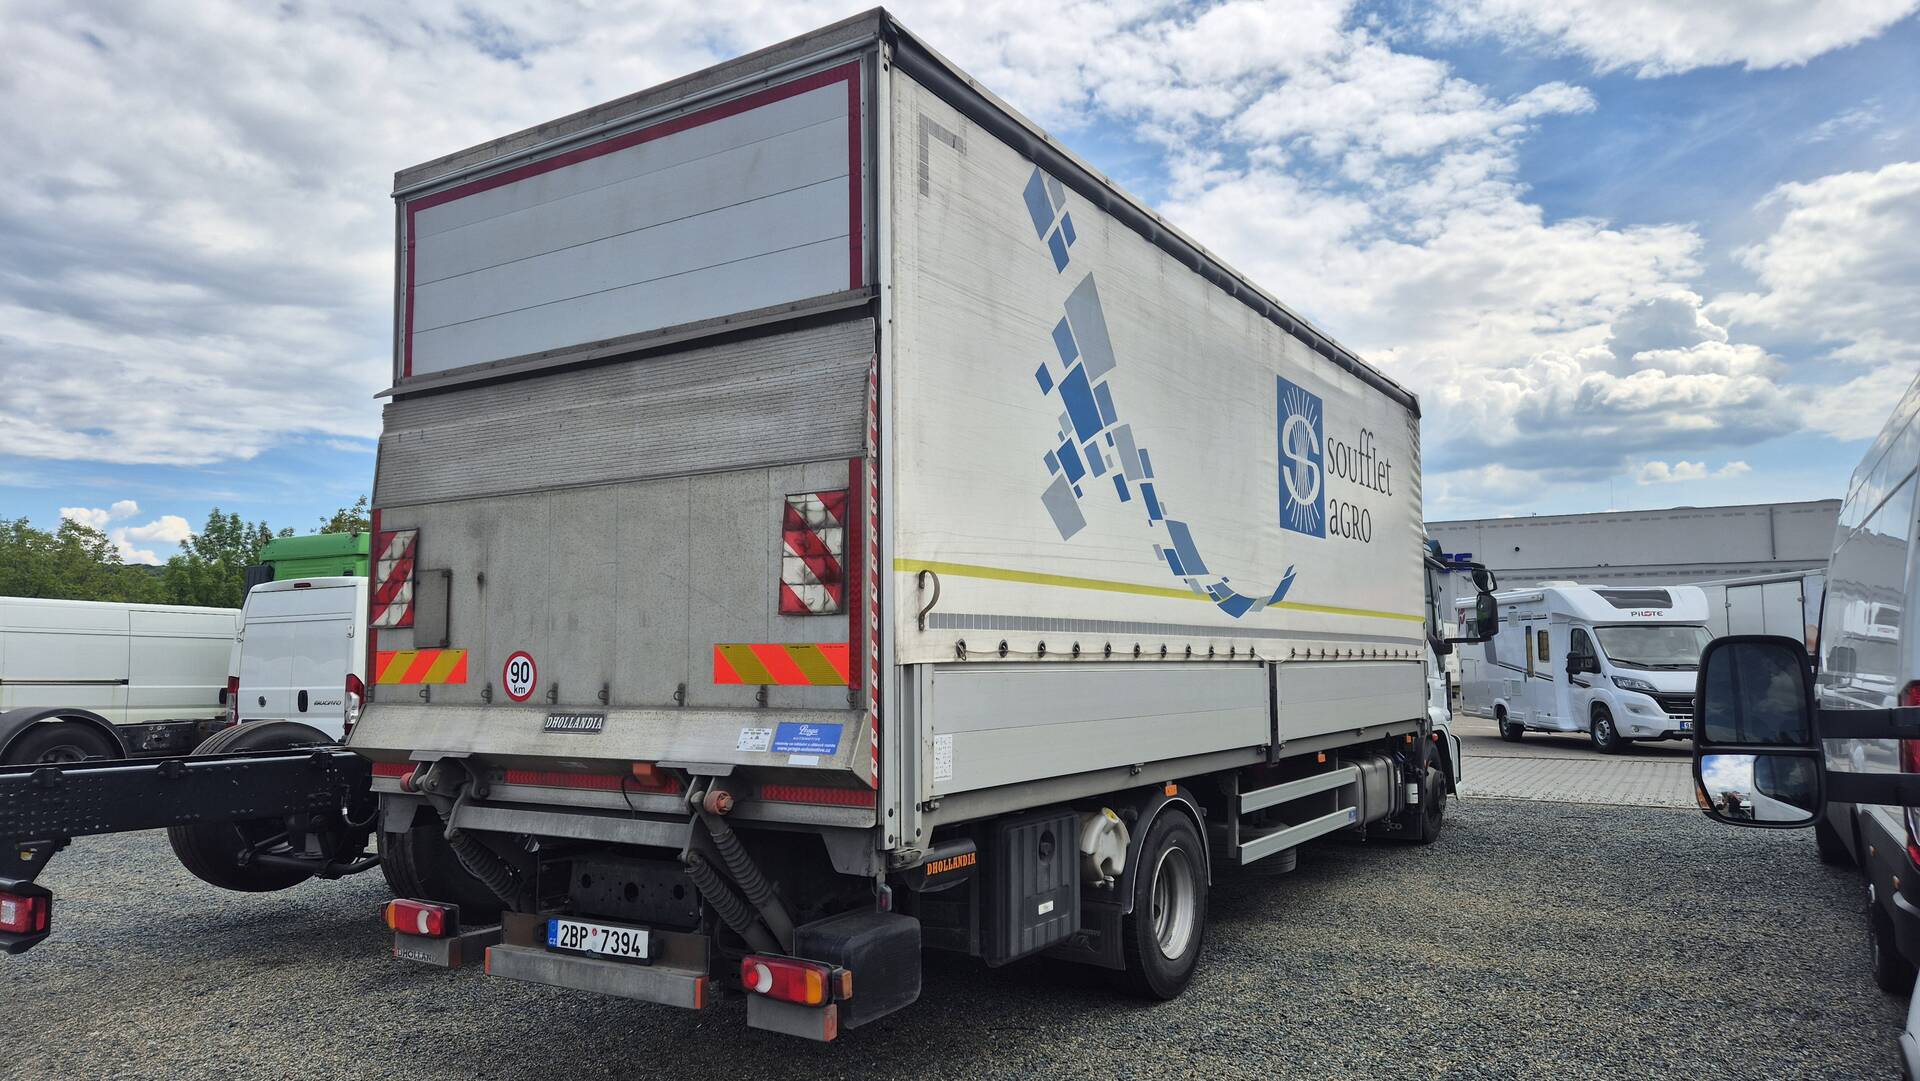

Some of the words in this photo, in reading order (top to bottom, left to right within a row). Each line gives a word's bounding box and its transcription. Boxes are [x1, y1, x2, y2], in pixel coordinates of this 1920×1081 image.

[1327, 428, 1393, 497] soufflet
[510, 661, 530, 684] 90
[513, 685, 526, 694] km
[545, 716, 604, 729] DHOLLANDIA
[926, 851, 977, 876] DHOLLANDIA
[560, 924, 589, 949] 2BP
[600, 929, 641, 957] 7394
